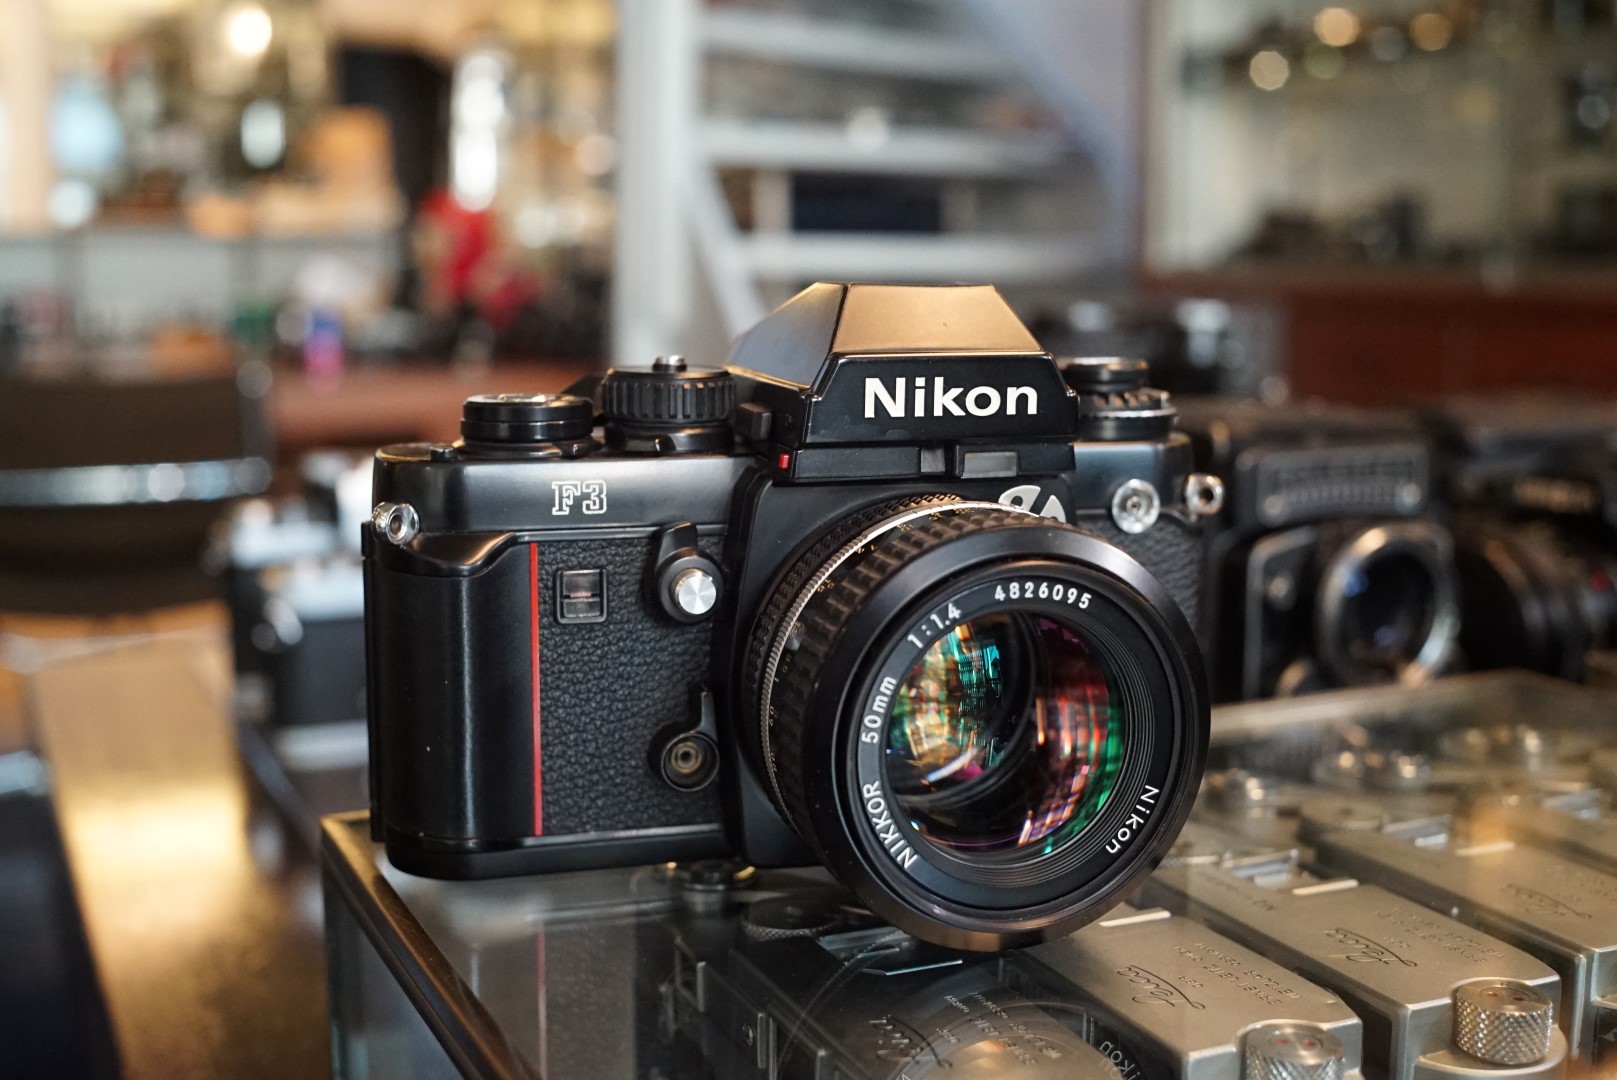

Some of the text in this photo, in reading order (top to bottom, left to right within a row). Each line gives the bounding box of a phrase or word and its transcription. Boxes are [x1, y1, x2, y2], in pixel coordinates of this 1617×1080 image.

[864, 376, 1038, 418] Nikon
[551, 480, 607, 516] F3
[995, 581, 1093, 609] 4826095
[861, 602, 963, 869] NIKKOR 50mm 1:1.4
[1105, 784, 1159, 854] Nikon
[1115, 965, 1205, 1010] Leica
